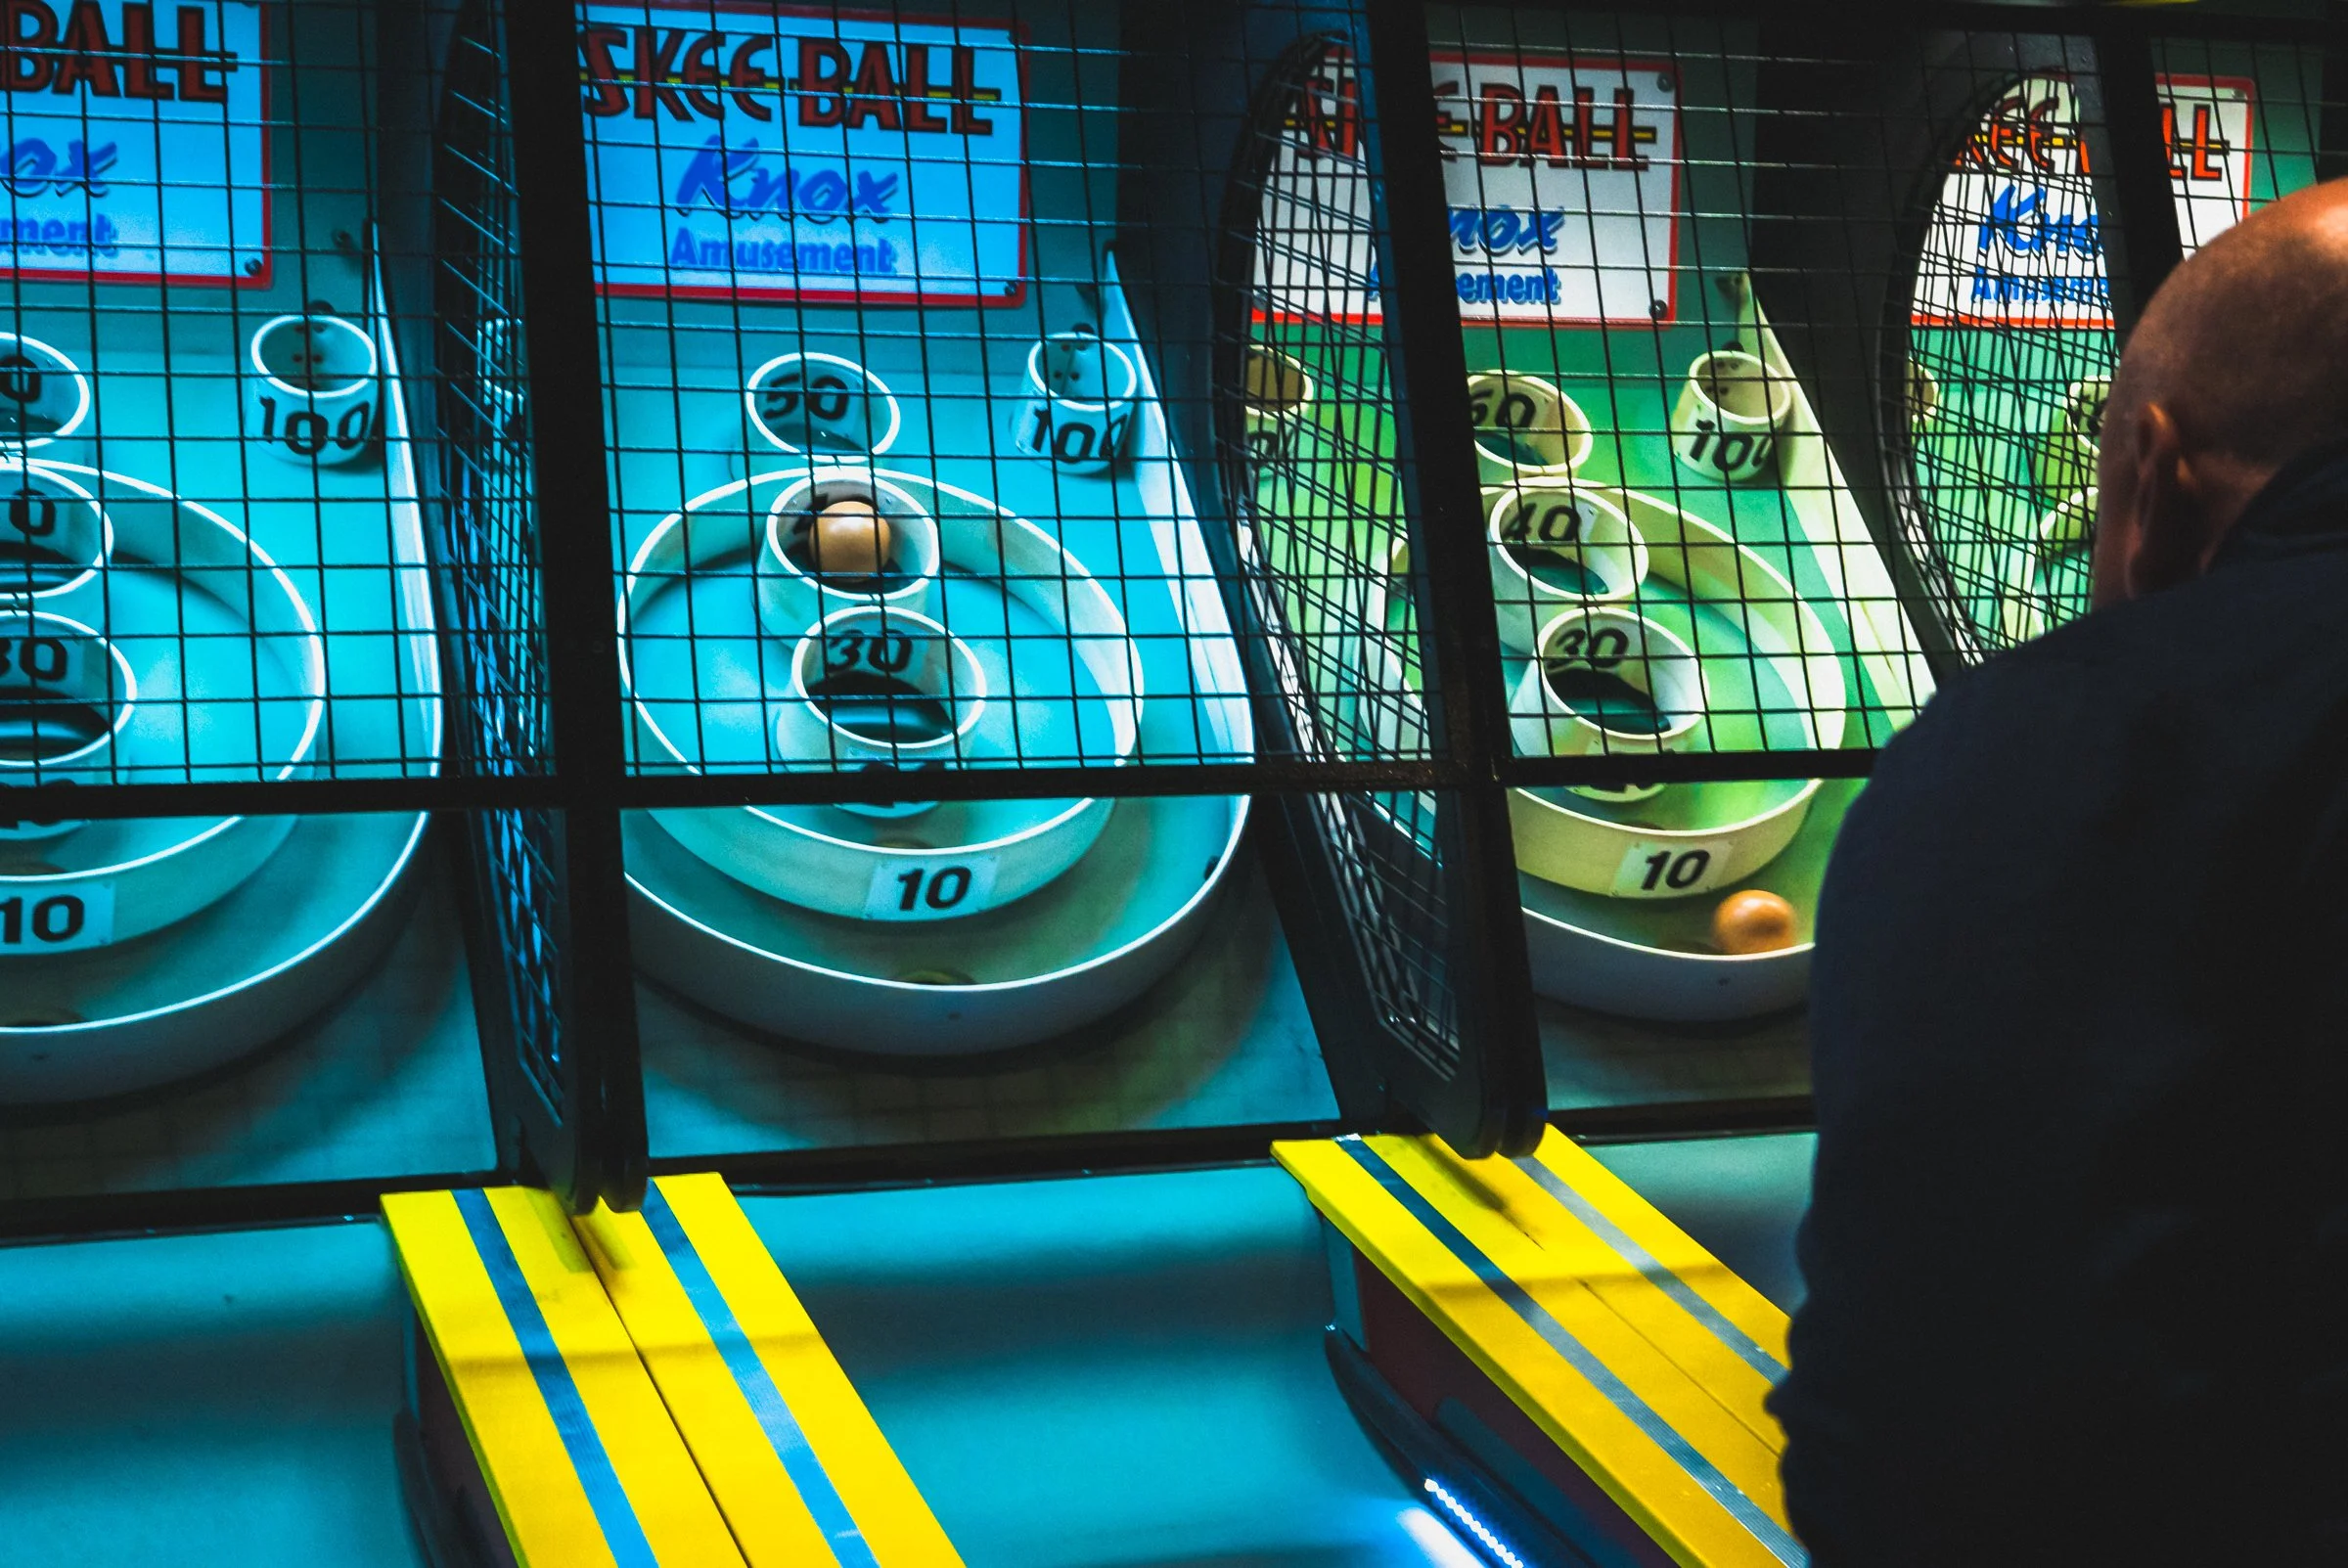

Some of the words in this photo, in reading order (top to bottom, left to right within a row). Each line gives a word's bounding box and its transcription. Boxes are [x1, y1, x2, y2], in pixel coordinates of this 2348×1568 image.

[0, 0, 238, 103] BALL
[577, 25, 773, 122] SKEE
[797, 37, 1002, 136] BALL
[1479, 82, 1656, 171] BALL
[2159, 104, 2230, 181] LL
[676, 134, 898, 225] Knox
[670, 227, 897, 276] Amusement
[1448, 203, 1565, 256] nox
[1455, 266, 1561, 304] ement
[0, 355, 41, 403] 0
[763, 373, 850, 421] 50
[259, 395, 371, 456] 100
[9, 487, 56, 536] 0
[1502, 502, 1582, 542] 40
[826, 628, 913, 673] 30
[1547, 628, 1629, 669] 30
[897, 866, 972, 912] 10
[1641, 849, 1711, 891] 10
[0, 894, 85, 945] 10
